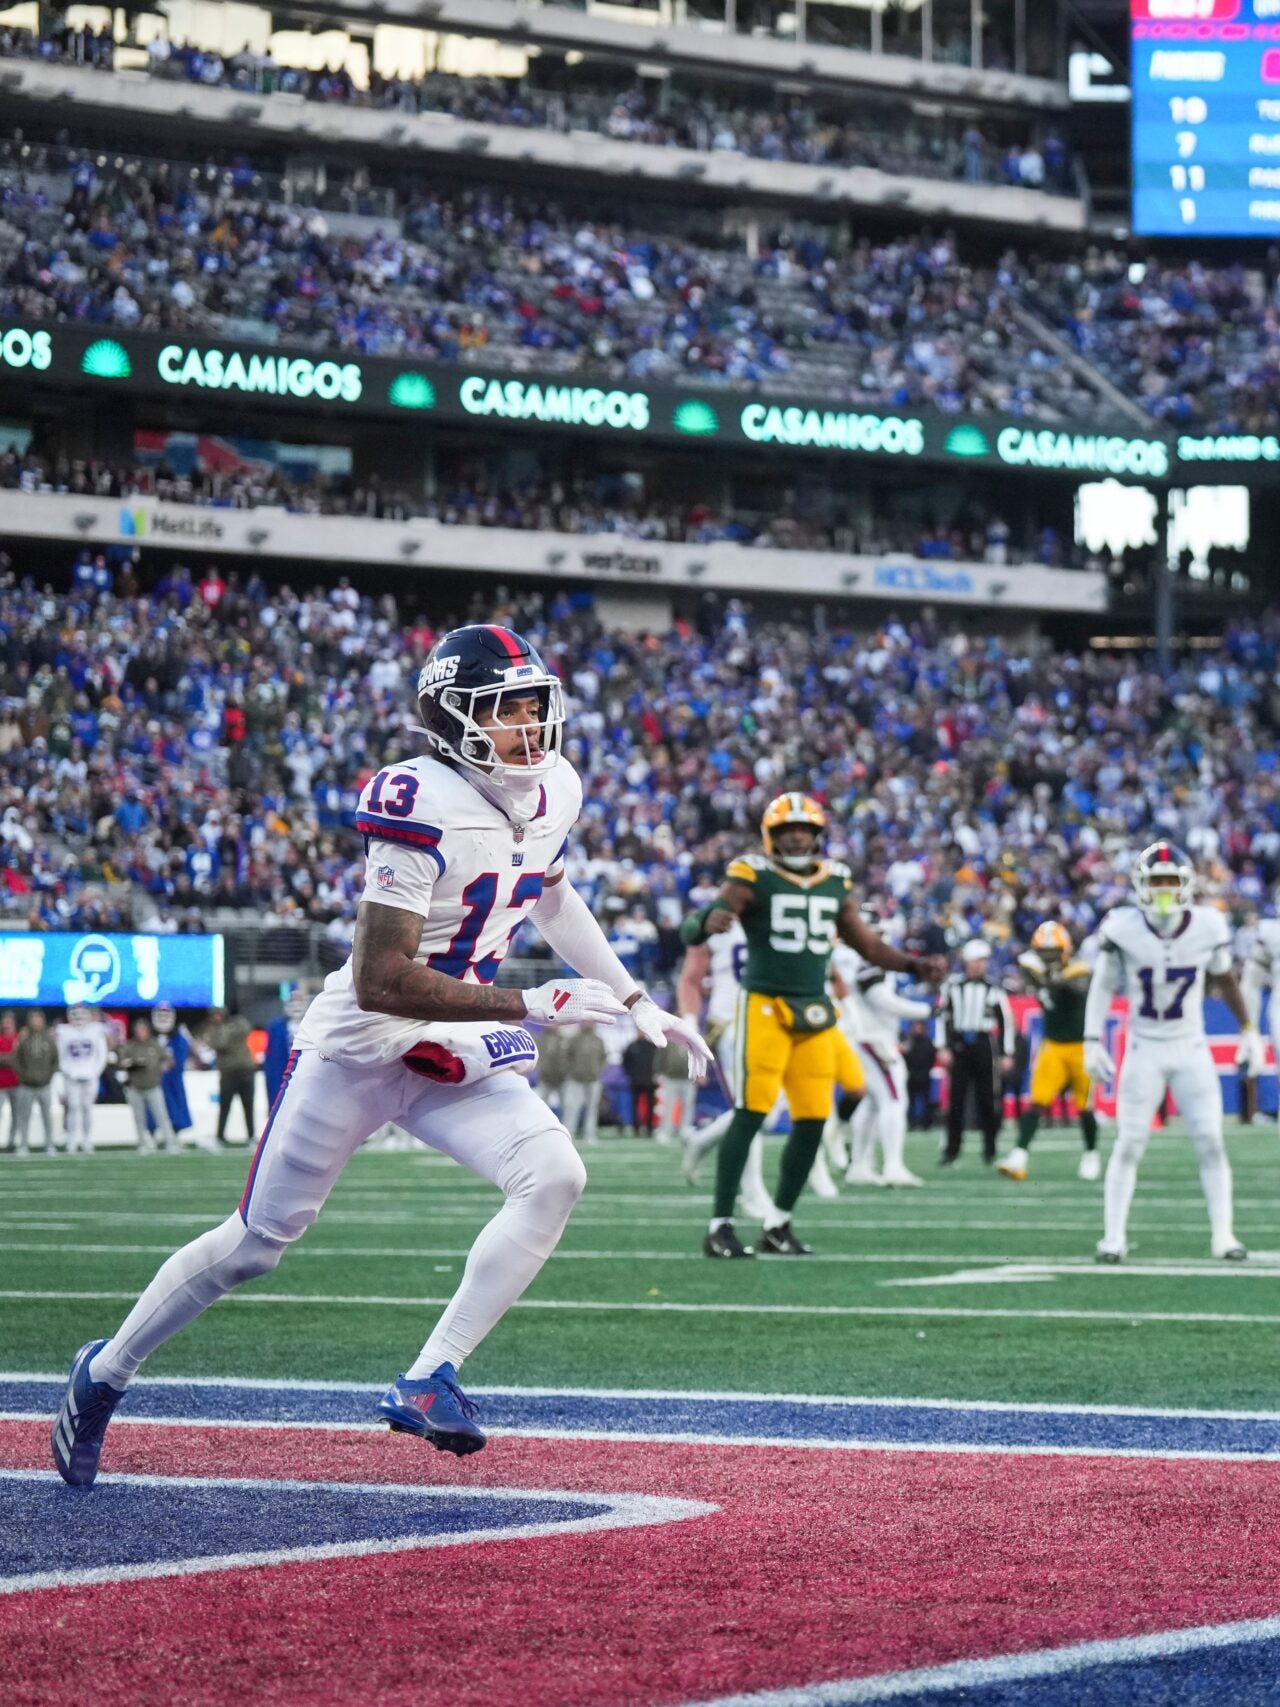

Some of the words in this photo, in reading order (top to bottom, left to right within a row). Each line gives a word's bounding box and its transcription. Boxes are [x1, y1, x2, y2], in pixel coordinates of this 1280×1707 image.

[0, 328, 52, 370] OS
[158, 345, 362, 402] CASAMIGOS
[460, 376, 650, 430] CASAMIGOS
[740, 403, 925, 456] CASAMIGOS
[996, 427, 1169, 477] CASAMIGOS
[367, 771, 420, 818] 13
[769, 893, 839, 954] 55
[1137, 966, 1198, 1020] 17
[481, 1029, 535, 1060] GIANTS
